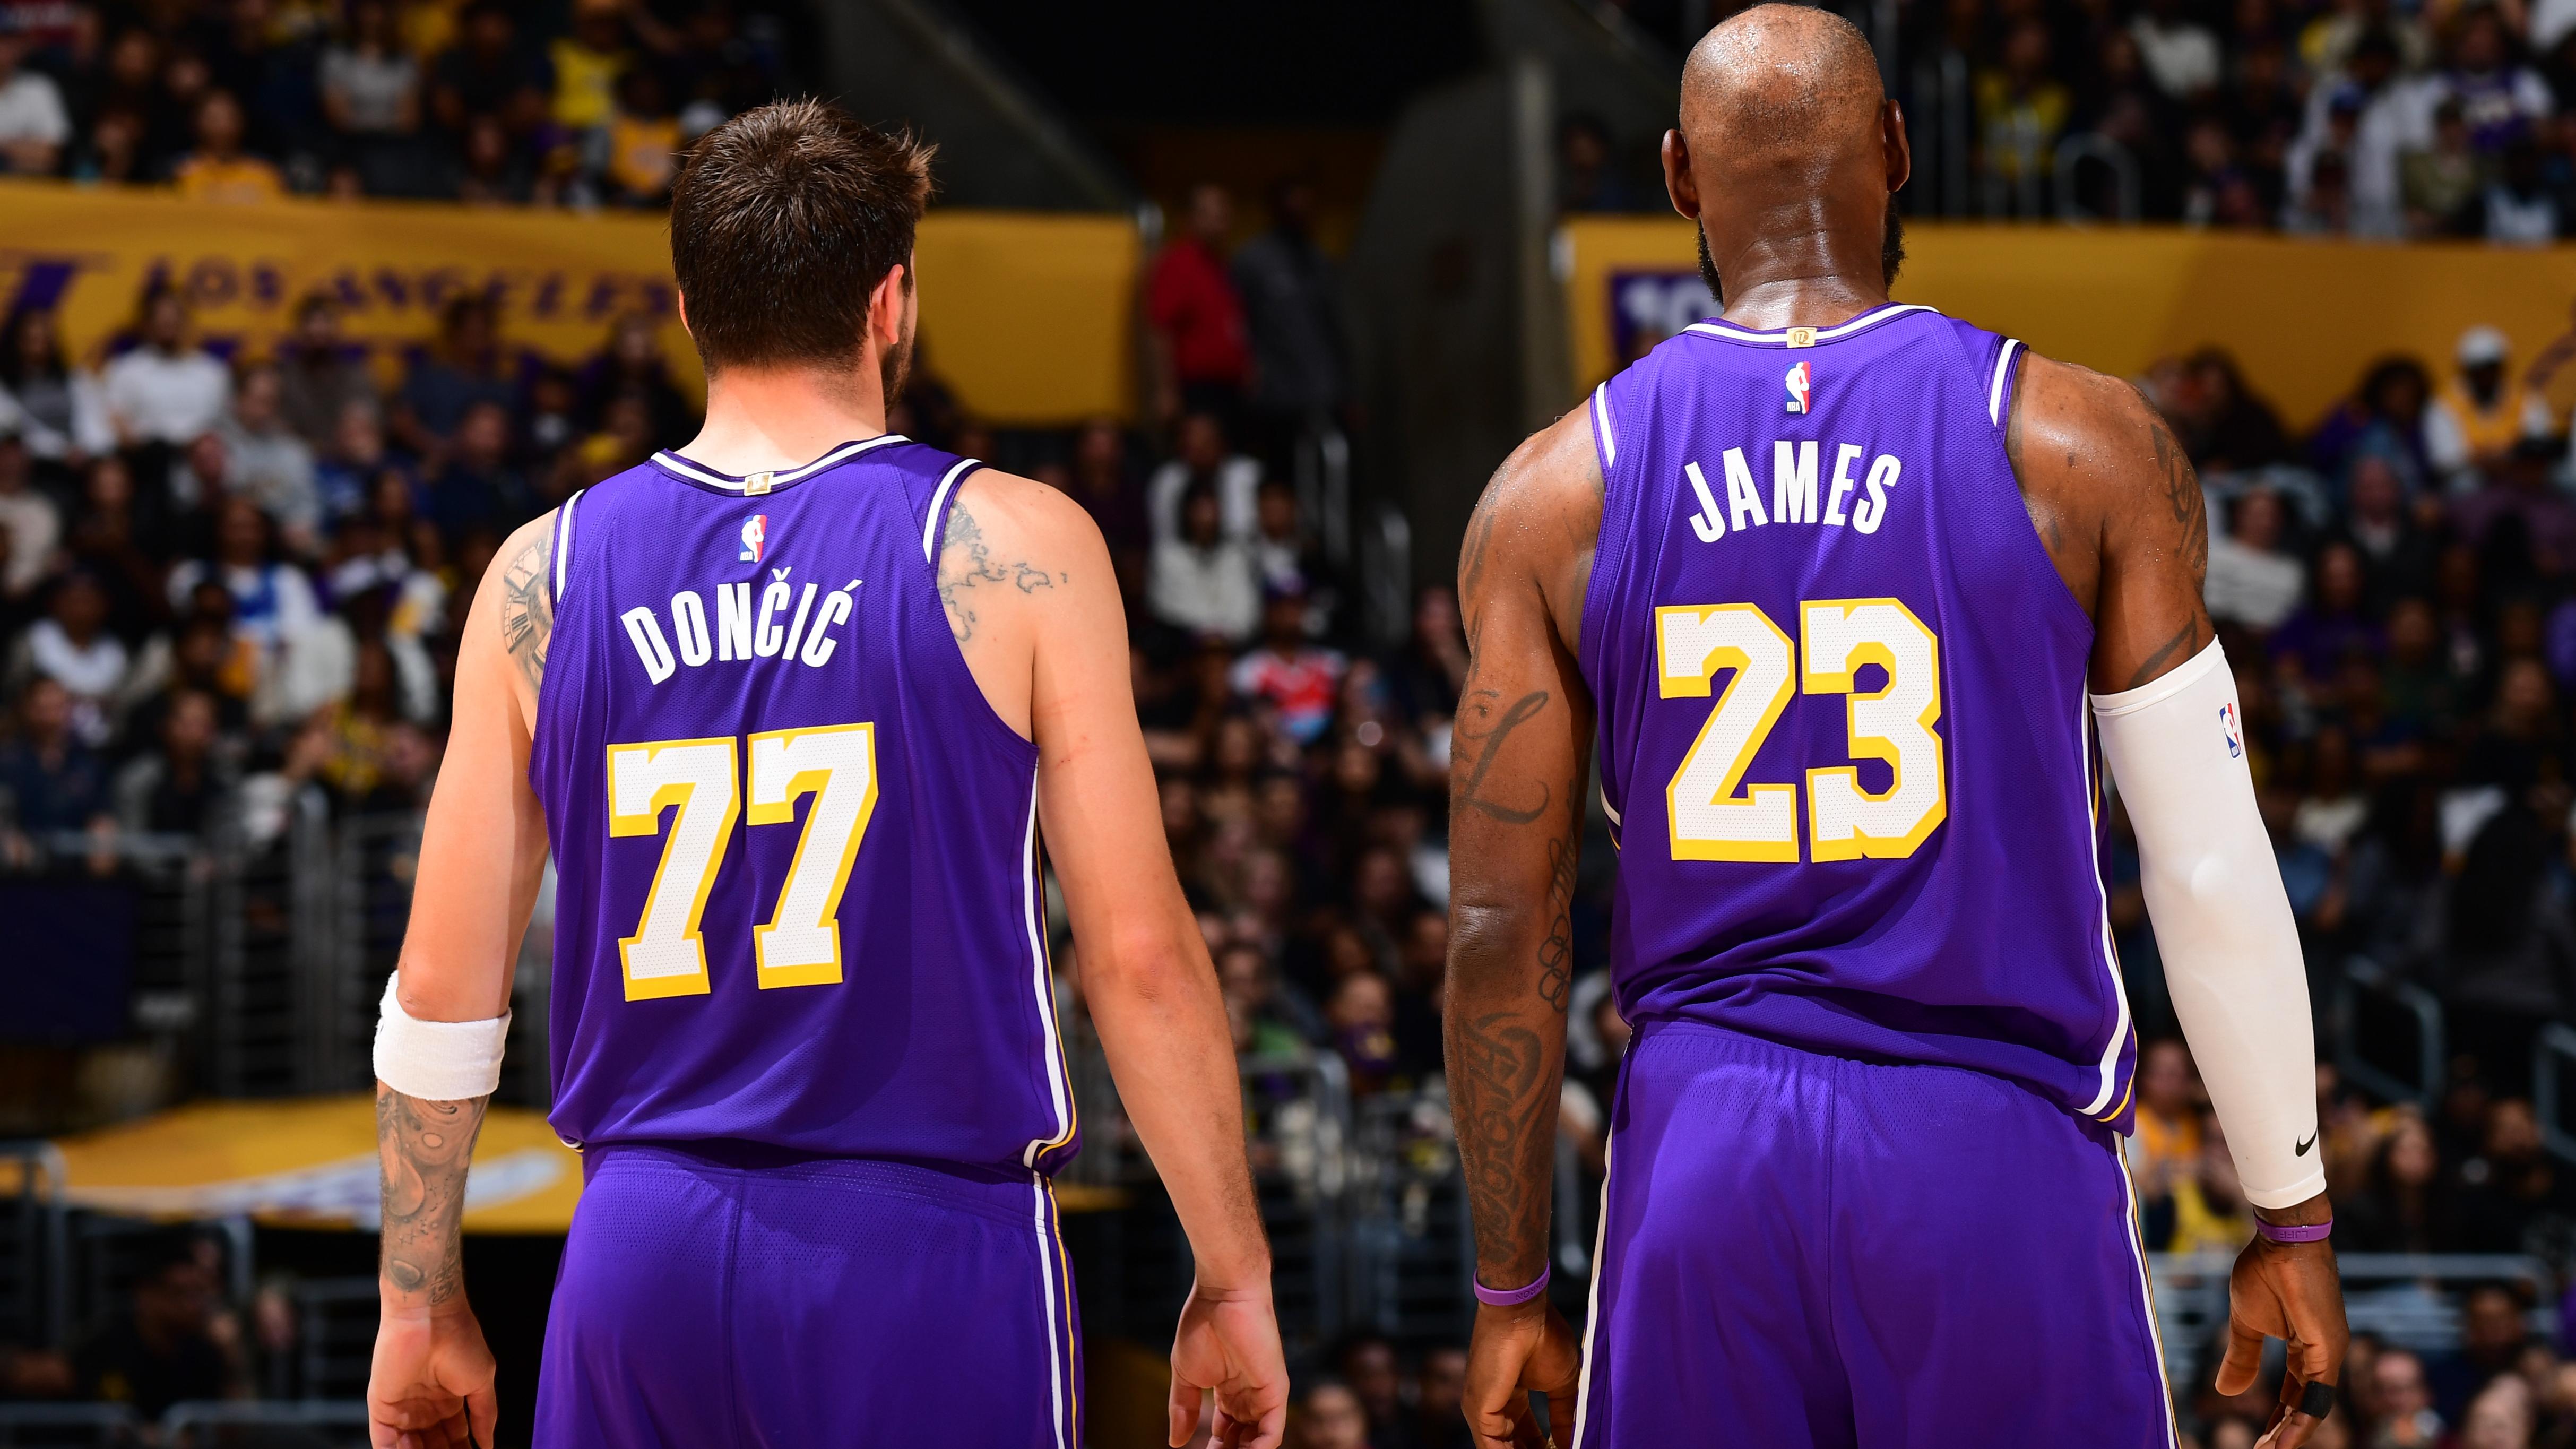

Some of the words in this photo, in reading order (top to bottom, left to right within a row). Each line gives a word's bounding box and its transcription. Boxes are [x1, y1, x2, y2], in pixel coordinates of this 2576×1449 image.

[1787, 401, 1800, 411] NBA
[1684, 441, 1901, 542] JAMES
[740, 551, 753, 561] NBA
[620, 566, 863, 685] DONČIĆ
[1655, 597, 1947, 864] 23
[606, 721, 879, 1002] 77
[2280, 1230, 2309, 1240] LJFF
